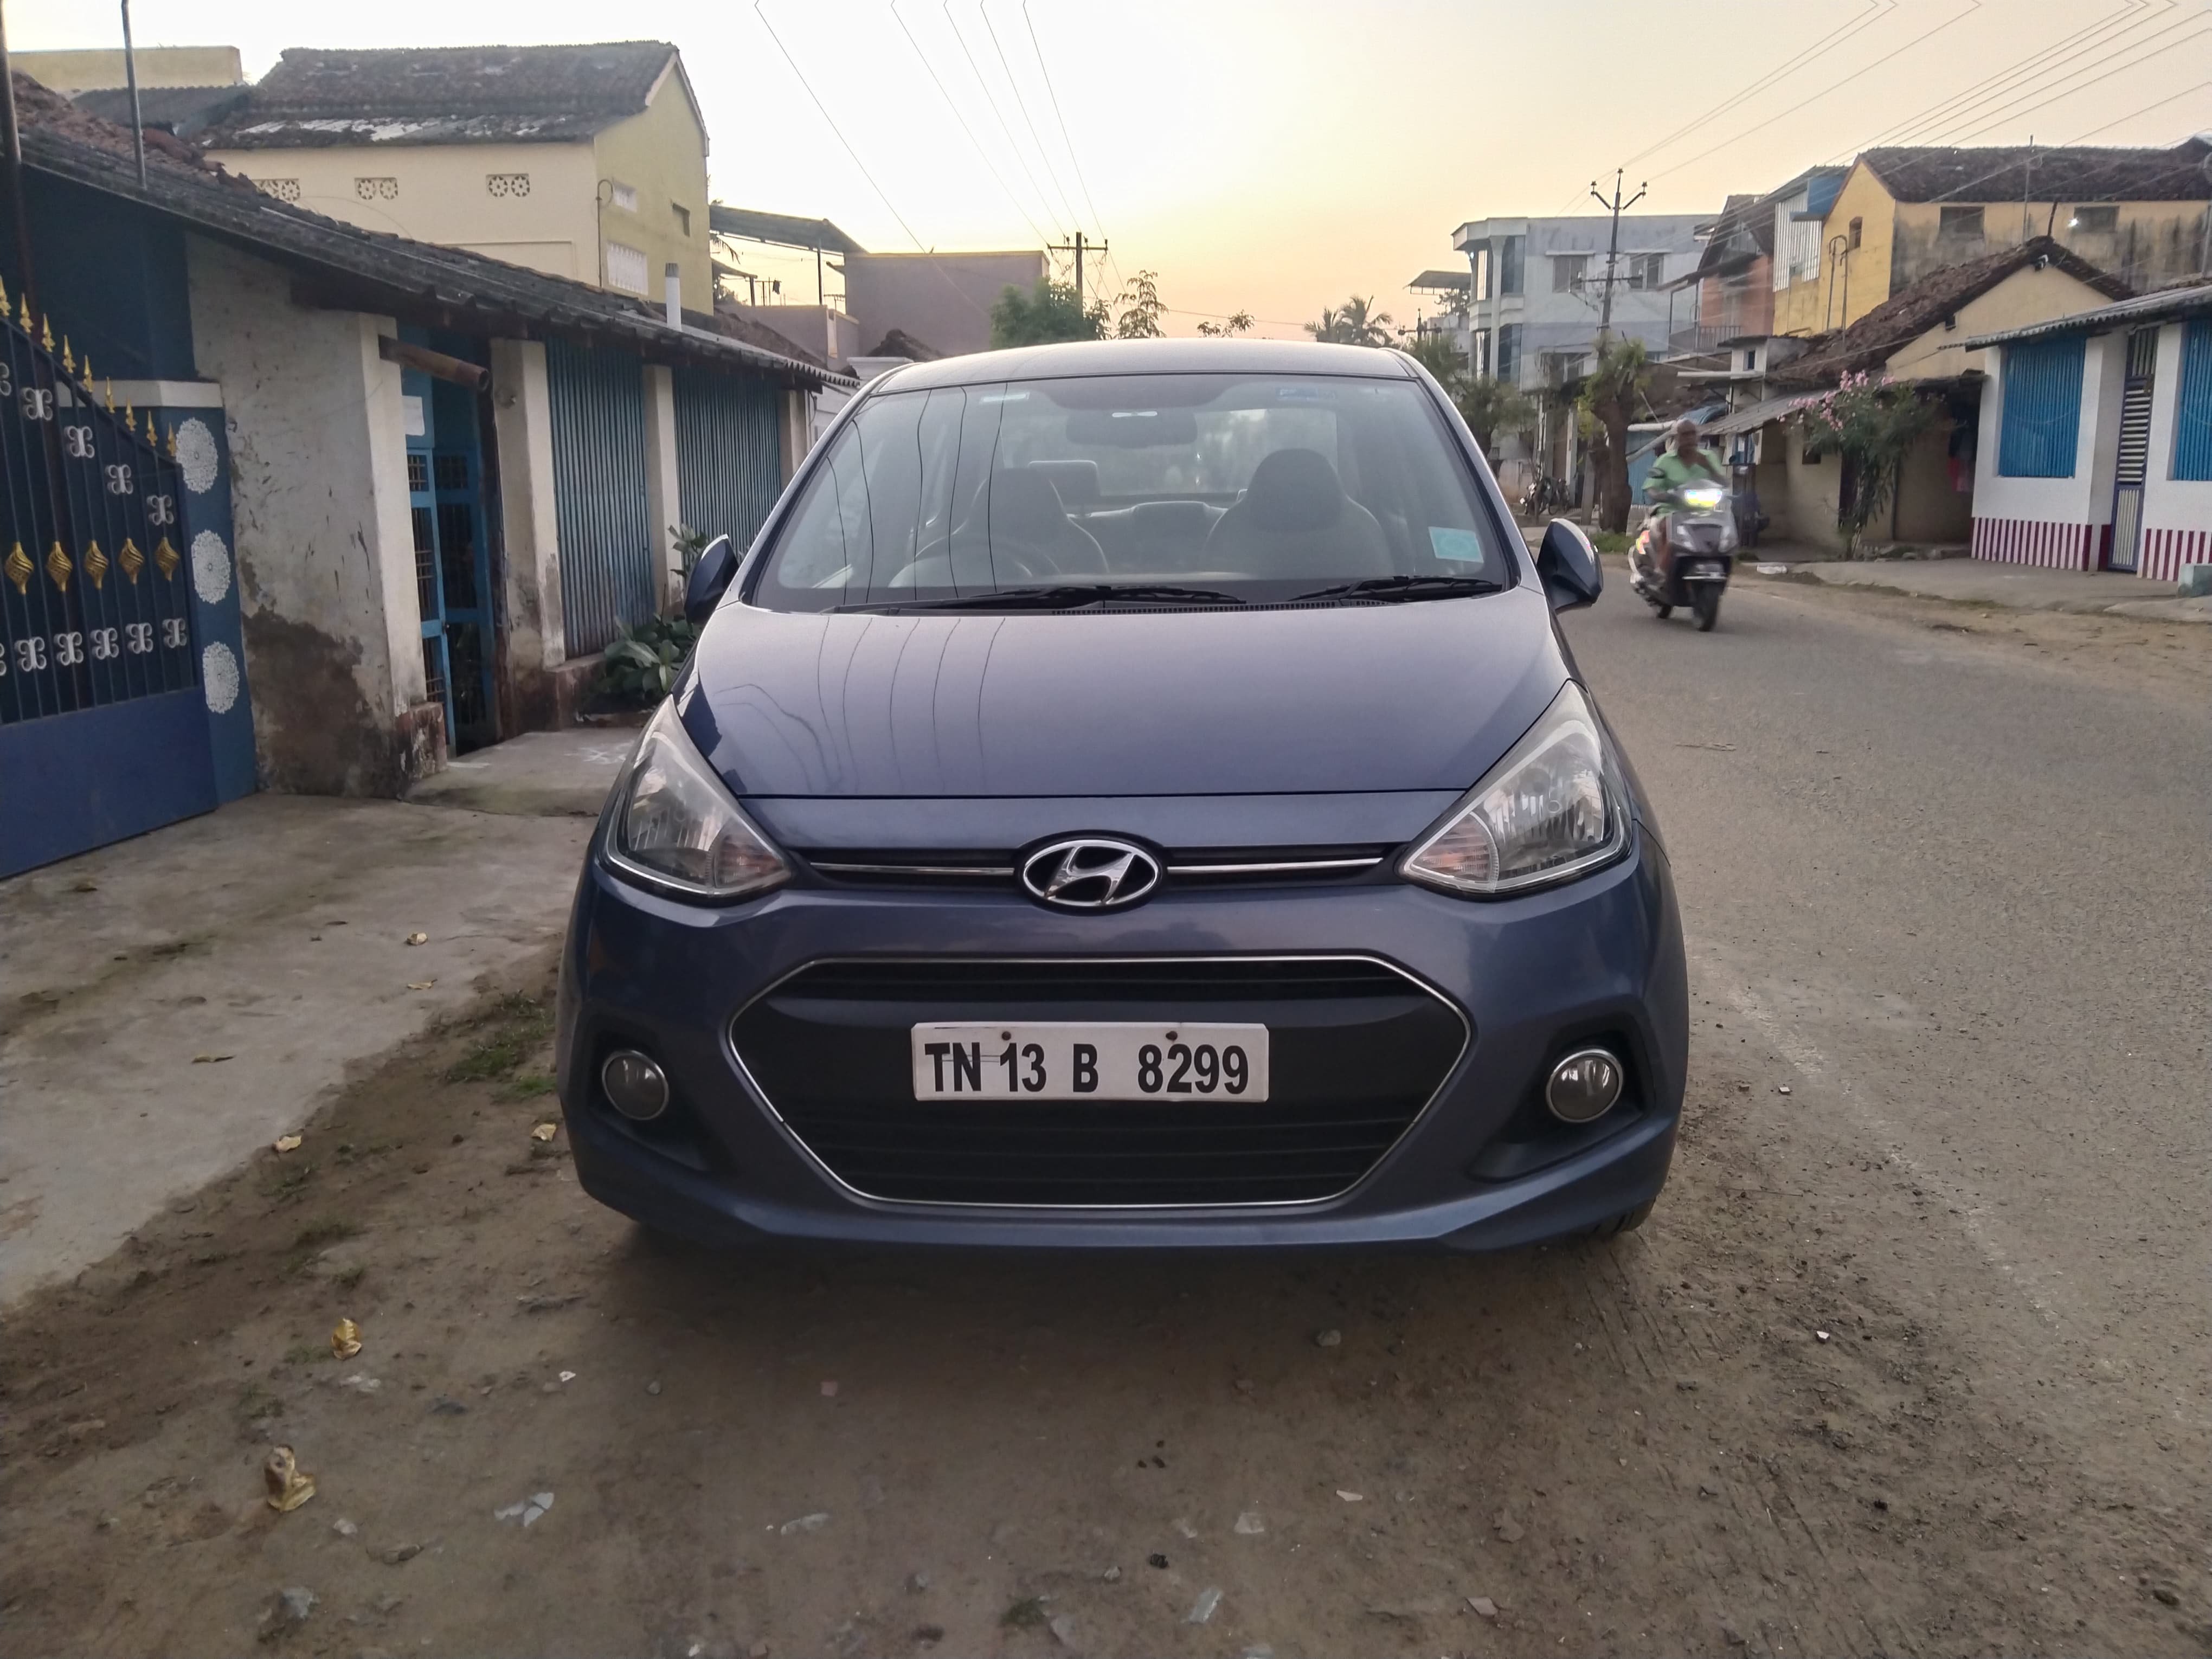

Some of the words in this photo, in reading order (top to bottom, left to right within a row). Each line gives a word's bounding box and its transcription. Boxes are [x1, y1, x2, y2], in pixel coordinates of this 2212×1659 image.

[924, 1042, 981, 1092] TN
[999, 1043, 1046, 1092] 13
[1072, 1043, 1098, 1093] B
[1137, 1043, 1249, 1095] 8299
